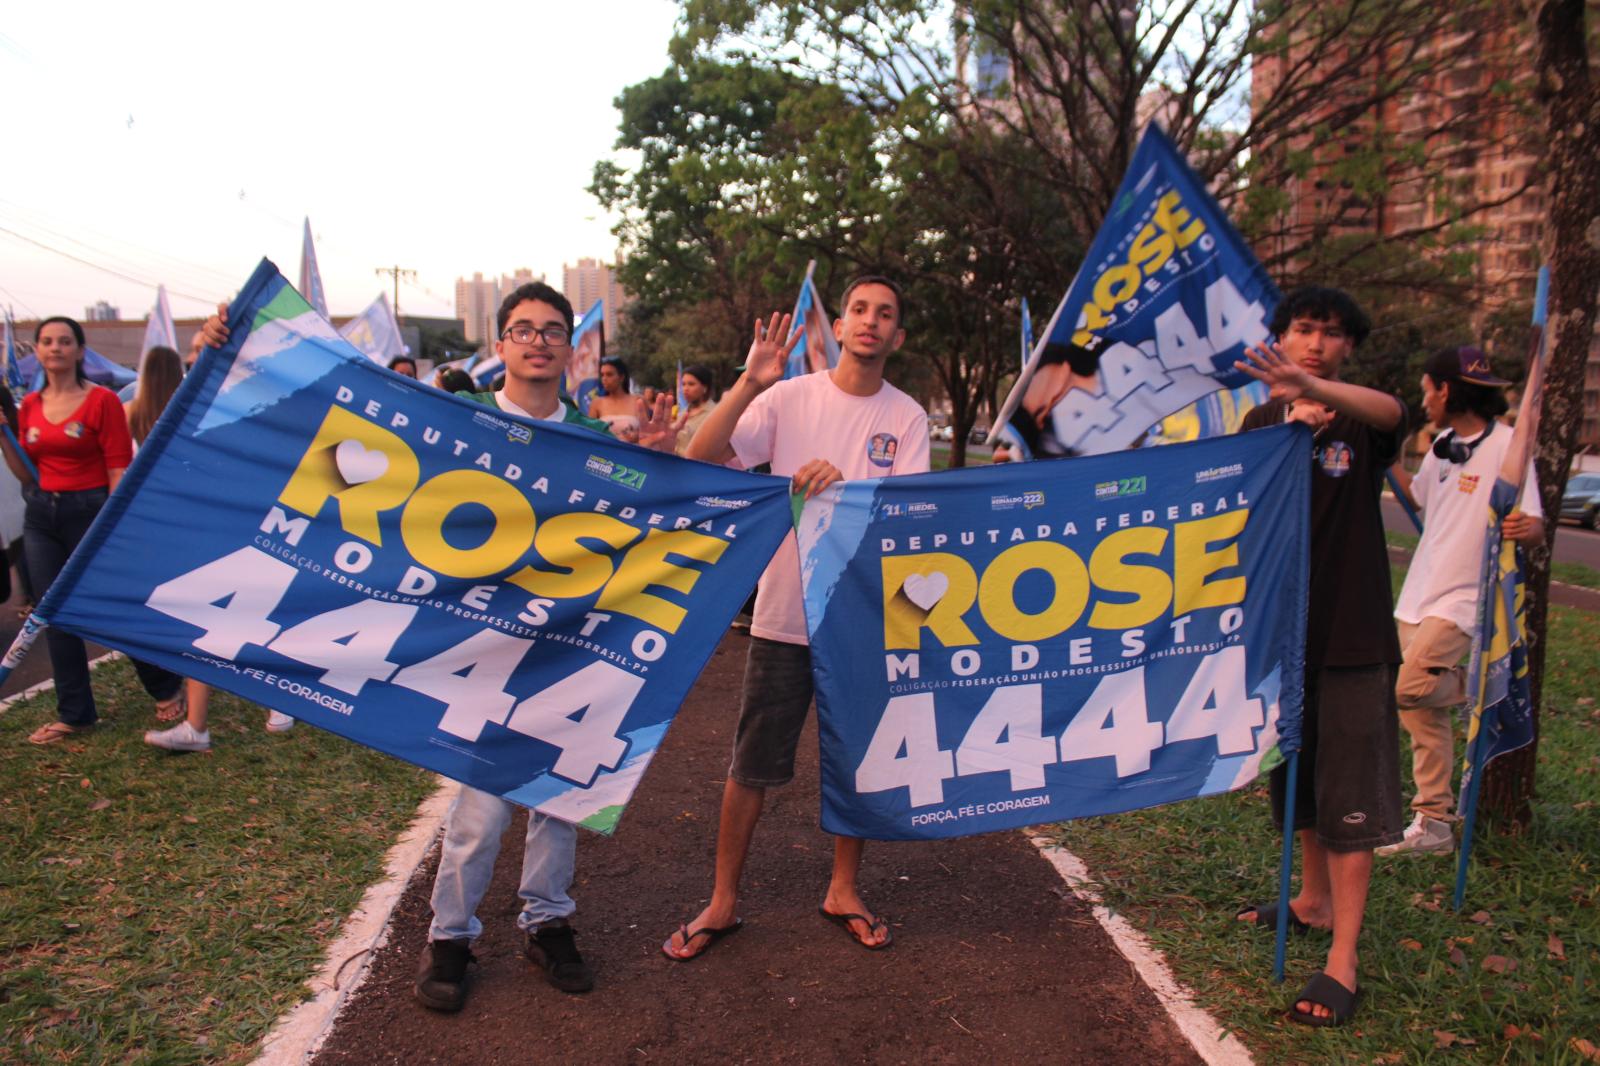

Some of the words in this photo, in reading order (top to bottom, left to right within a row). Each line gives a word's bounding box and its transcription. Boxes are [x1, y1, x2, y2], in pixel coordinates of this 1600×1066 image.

[1071, 189, 1206, 347] ROSE
[335, 386, 548, 493] DEPUTADA
[568, 489, 738, 538] FEDERAL
[509, 425, 530, 440] 222
[611, 463, 647, 489] 221
[1023, 494, 1042, 503] 222
[1119, 475, 1147, 496] 221
[278, 404, 729, 634] ROSE
[882, 521, 1078, 551] DEPUTADA
[1096, 493, 1249, 532] FEDERAL
[254, 535, 321, 573] COLIGAÇÃO
[322, 568, 398, 601] FEDERAÇÃO
[259, 506, 667, 661] MODESTO
[881, 508, 1249, 650] ROSE
[144, 545, 646, 786] 4444
[886, 607, 1244, 682] MODESTO
[243, 667, 265, 681] FÉ
[264, 674, 278, 685] E
[278, 678, 354, 716] CORAGEM
[890, 680, 948, 694] COLIGAÇÃO
[952, 674, 1018, 687] FEDERAÇÃO
[1022, 670, 1058, 681] UNIÃO
[855, 645, 1264, 808] 4444
[911, 808, 958, 827] FORÇA,
[958, 804, 975, 817] FÉ
[976, 804, 985, 815] E
[986, 794, 1050, 814] CORAGEM
